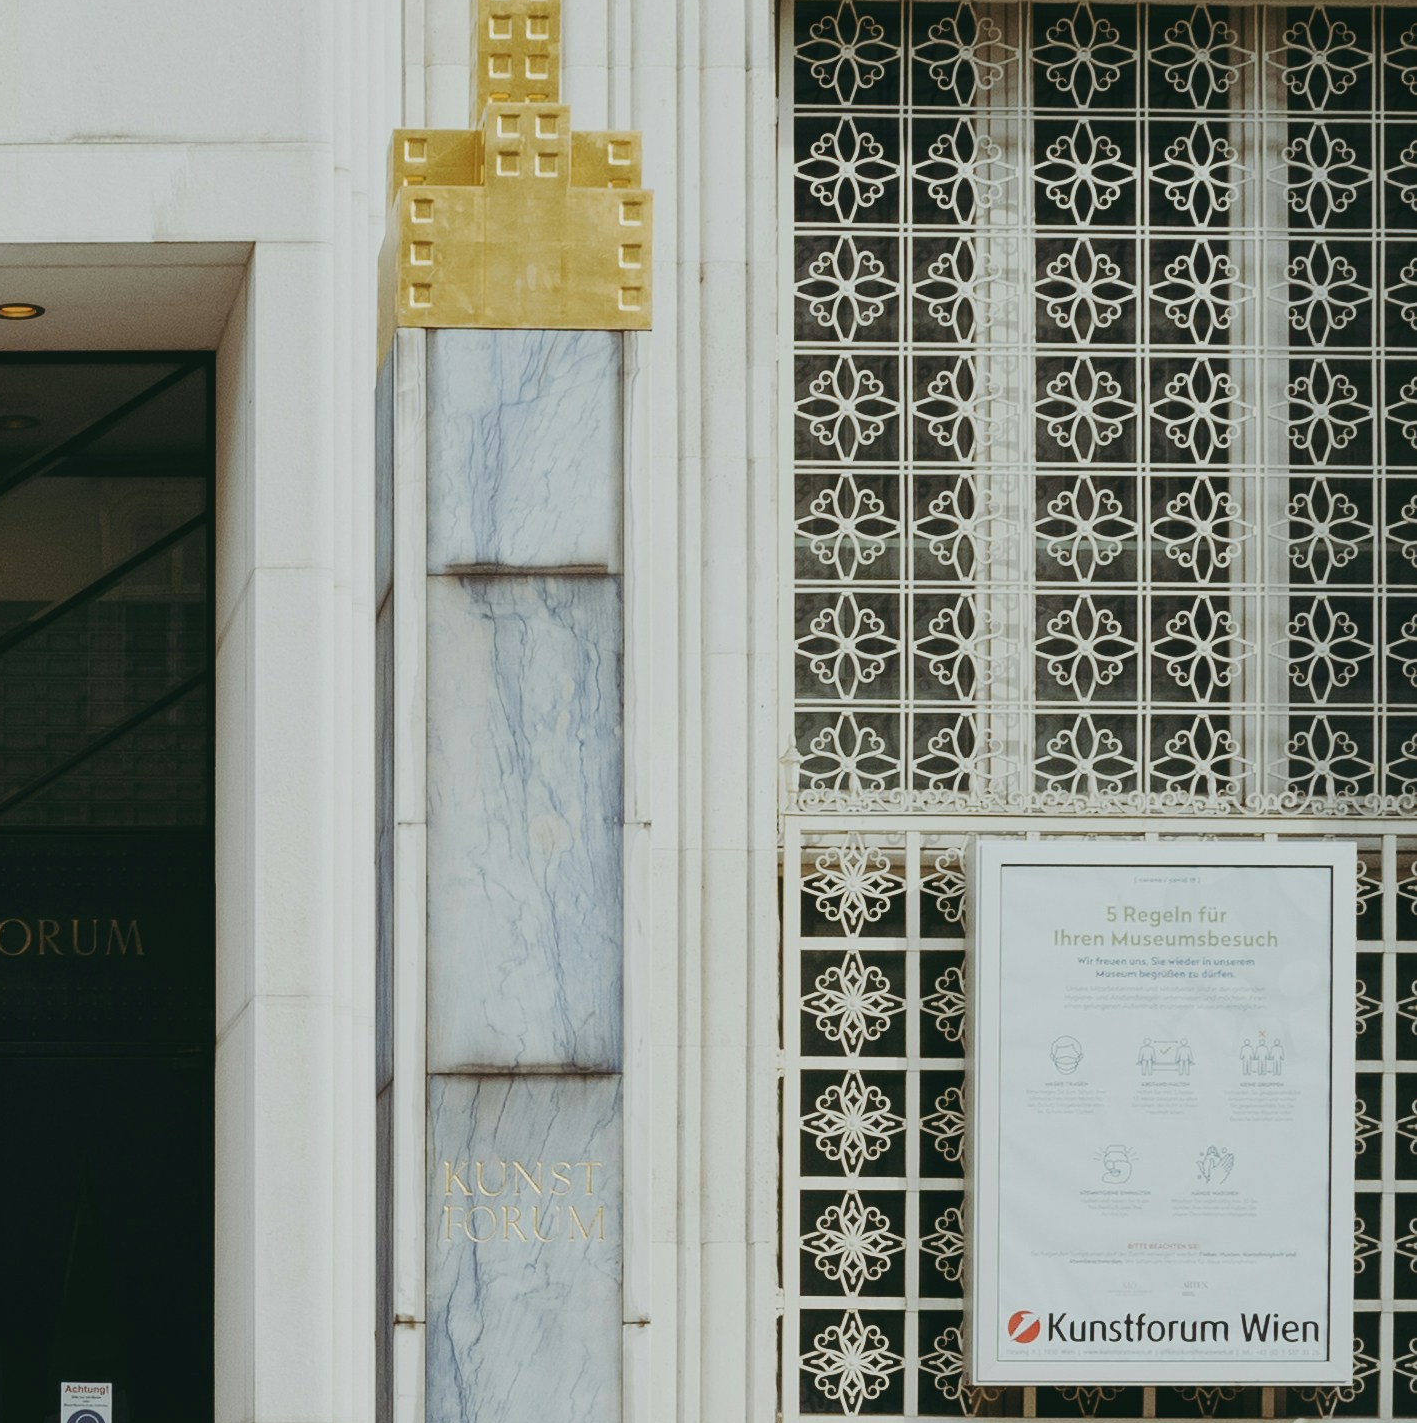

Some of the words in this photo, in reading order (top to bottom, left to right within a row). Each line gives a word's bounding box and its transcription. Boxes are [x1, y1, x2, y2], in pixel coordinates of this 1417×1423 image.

[1106, 905, 1118, 923] 5
[1123, 905, 1192, 928] Regeln
[1198, 905, 1228, 923] für
[1054, 930, 1105, 947] Ihren
[1111, 930, 1279, 947] Museumsbesuch
[1077, 956, 1094, 966] Wir
[1095, 956, 1127, 966] freuen
[1151, 956, 1166, 966] Sie
[1168, 956, 1200, 966] wieder
[1202, 956, 1212, 966] in
[1213, 958, 1255, 966] unserem
[1095, 969, 1137, 978] Museum
[1139, 969, 1186, 980] begrüßen
[444, 1160, 604, 1197] KUNST
[443, 1205, 606, 1243] FORUM
[1048, 1313, 1230, 1344] Kunstforum
[1240, 1313, 1320, 1344] Wien
[64, 1385, 110, 1395] Achtung!
